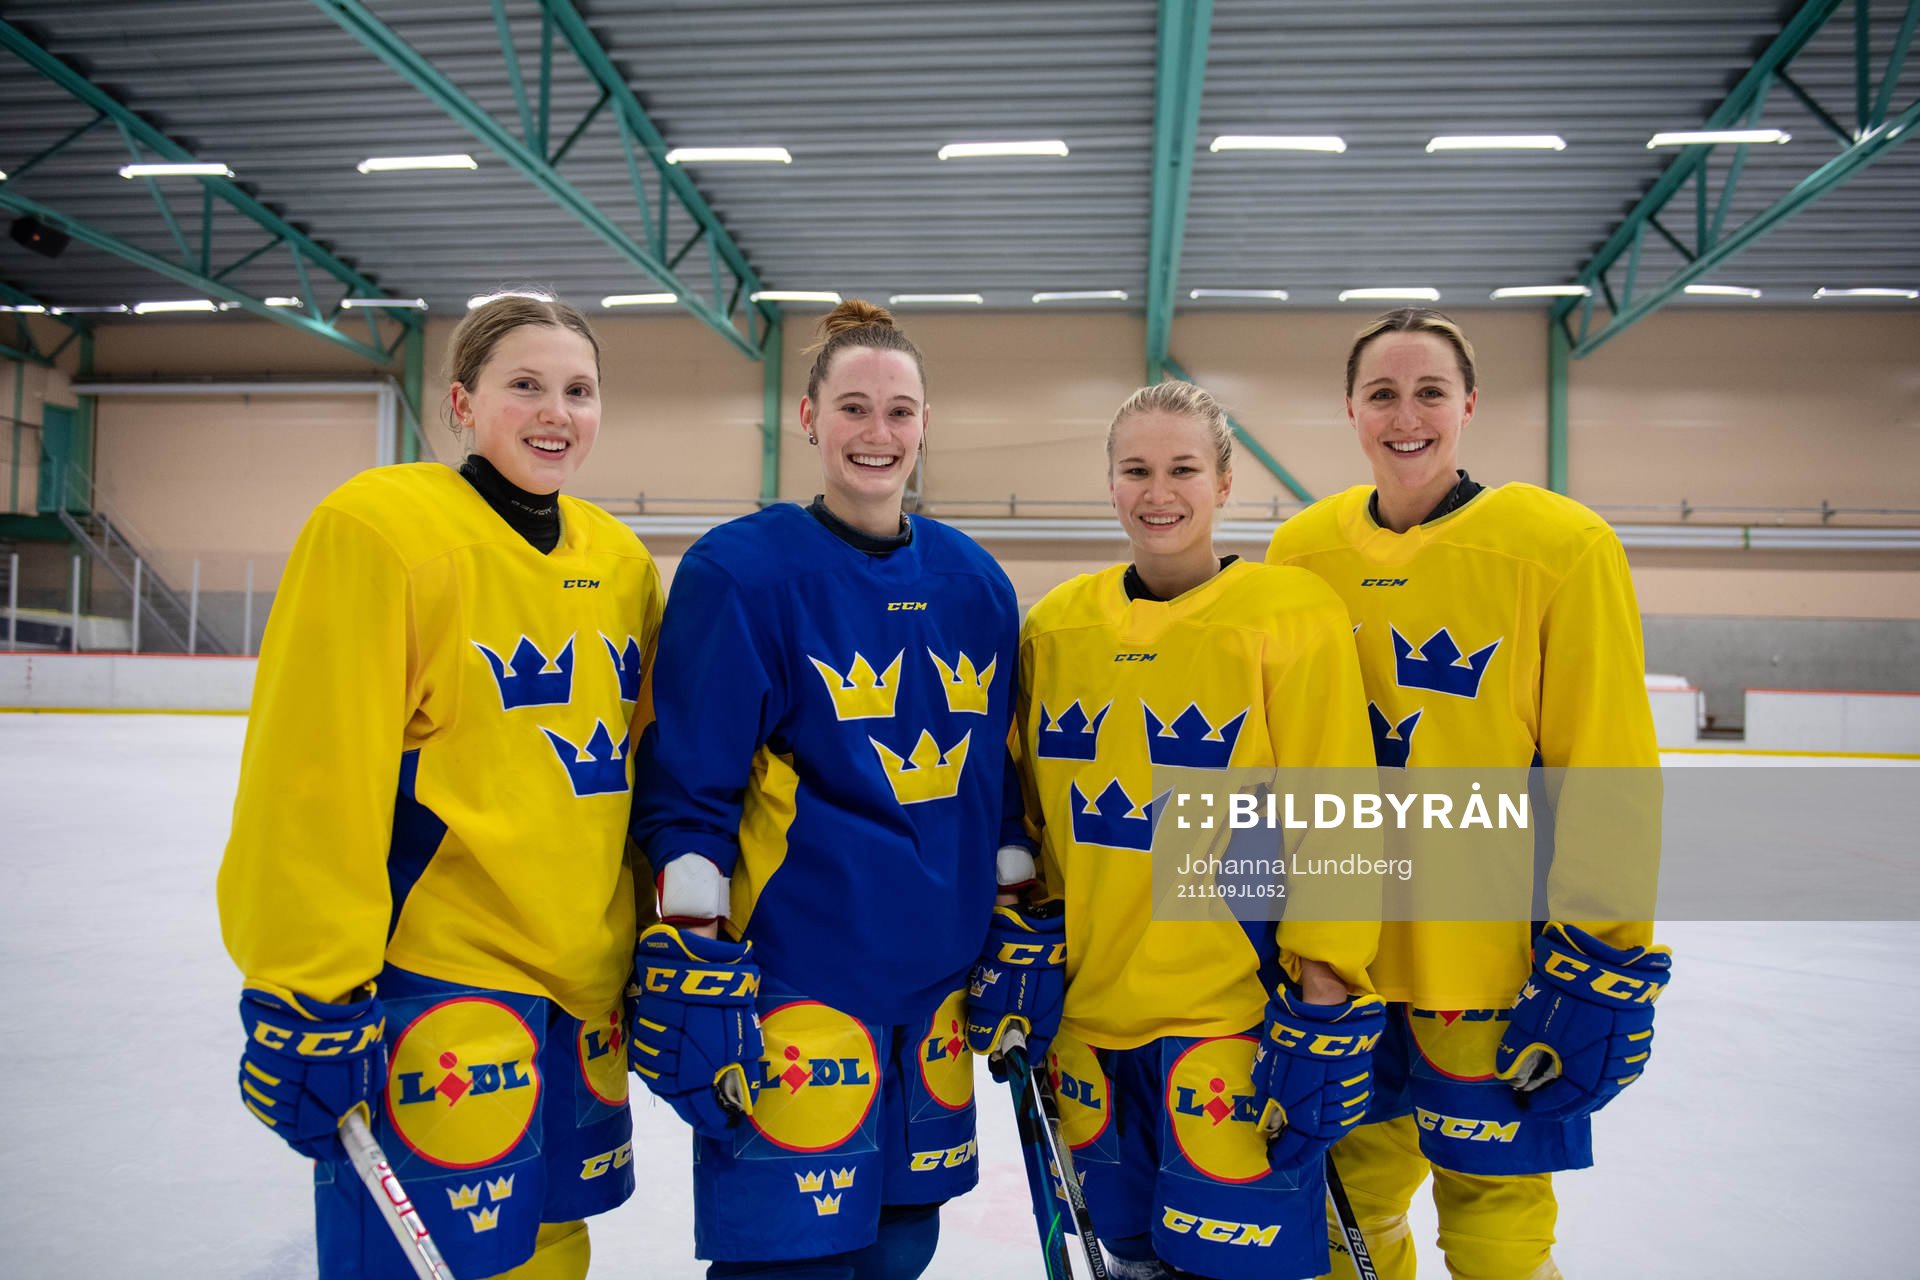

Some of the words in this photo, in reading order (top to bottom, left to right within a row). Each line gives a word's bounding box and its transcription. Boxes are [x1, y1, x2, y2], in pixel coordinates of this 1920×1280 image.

[563, 579, 600, 589] CCM
[1361, 578, 1409, 587] CCM
[887, 601, 928, 611] CCM
[1114, 653, 1158, 662] CCM
[645, 967, 761, 998] CCM
[1544, 950, 1668, 1004] CCM
[254, 1016, 386, 1056] CCM
[968, 1024, 993, 1034] CM
[1270, 1021, 1383, 1056] CCM
[1415, 1105, 1521, 1143] CCM
[580, 1139, 633, 1180] CC
[1162, 1205, 1282, 1247] CCM
[1084, 1230, 1106, 1279] BERGLUND
